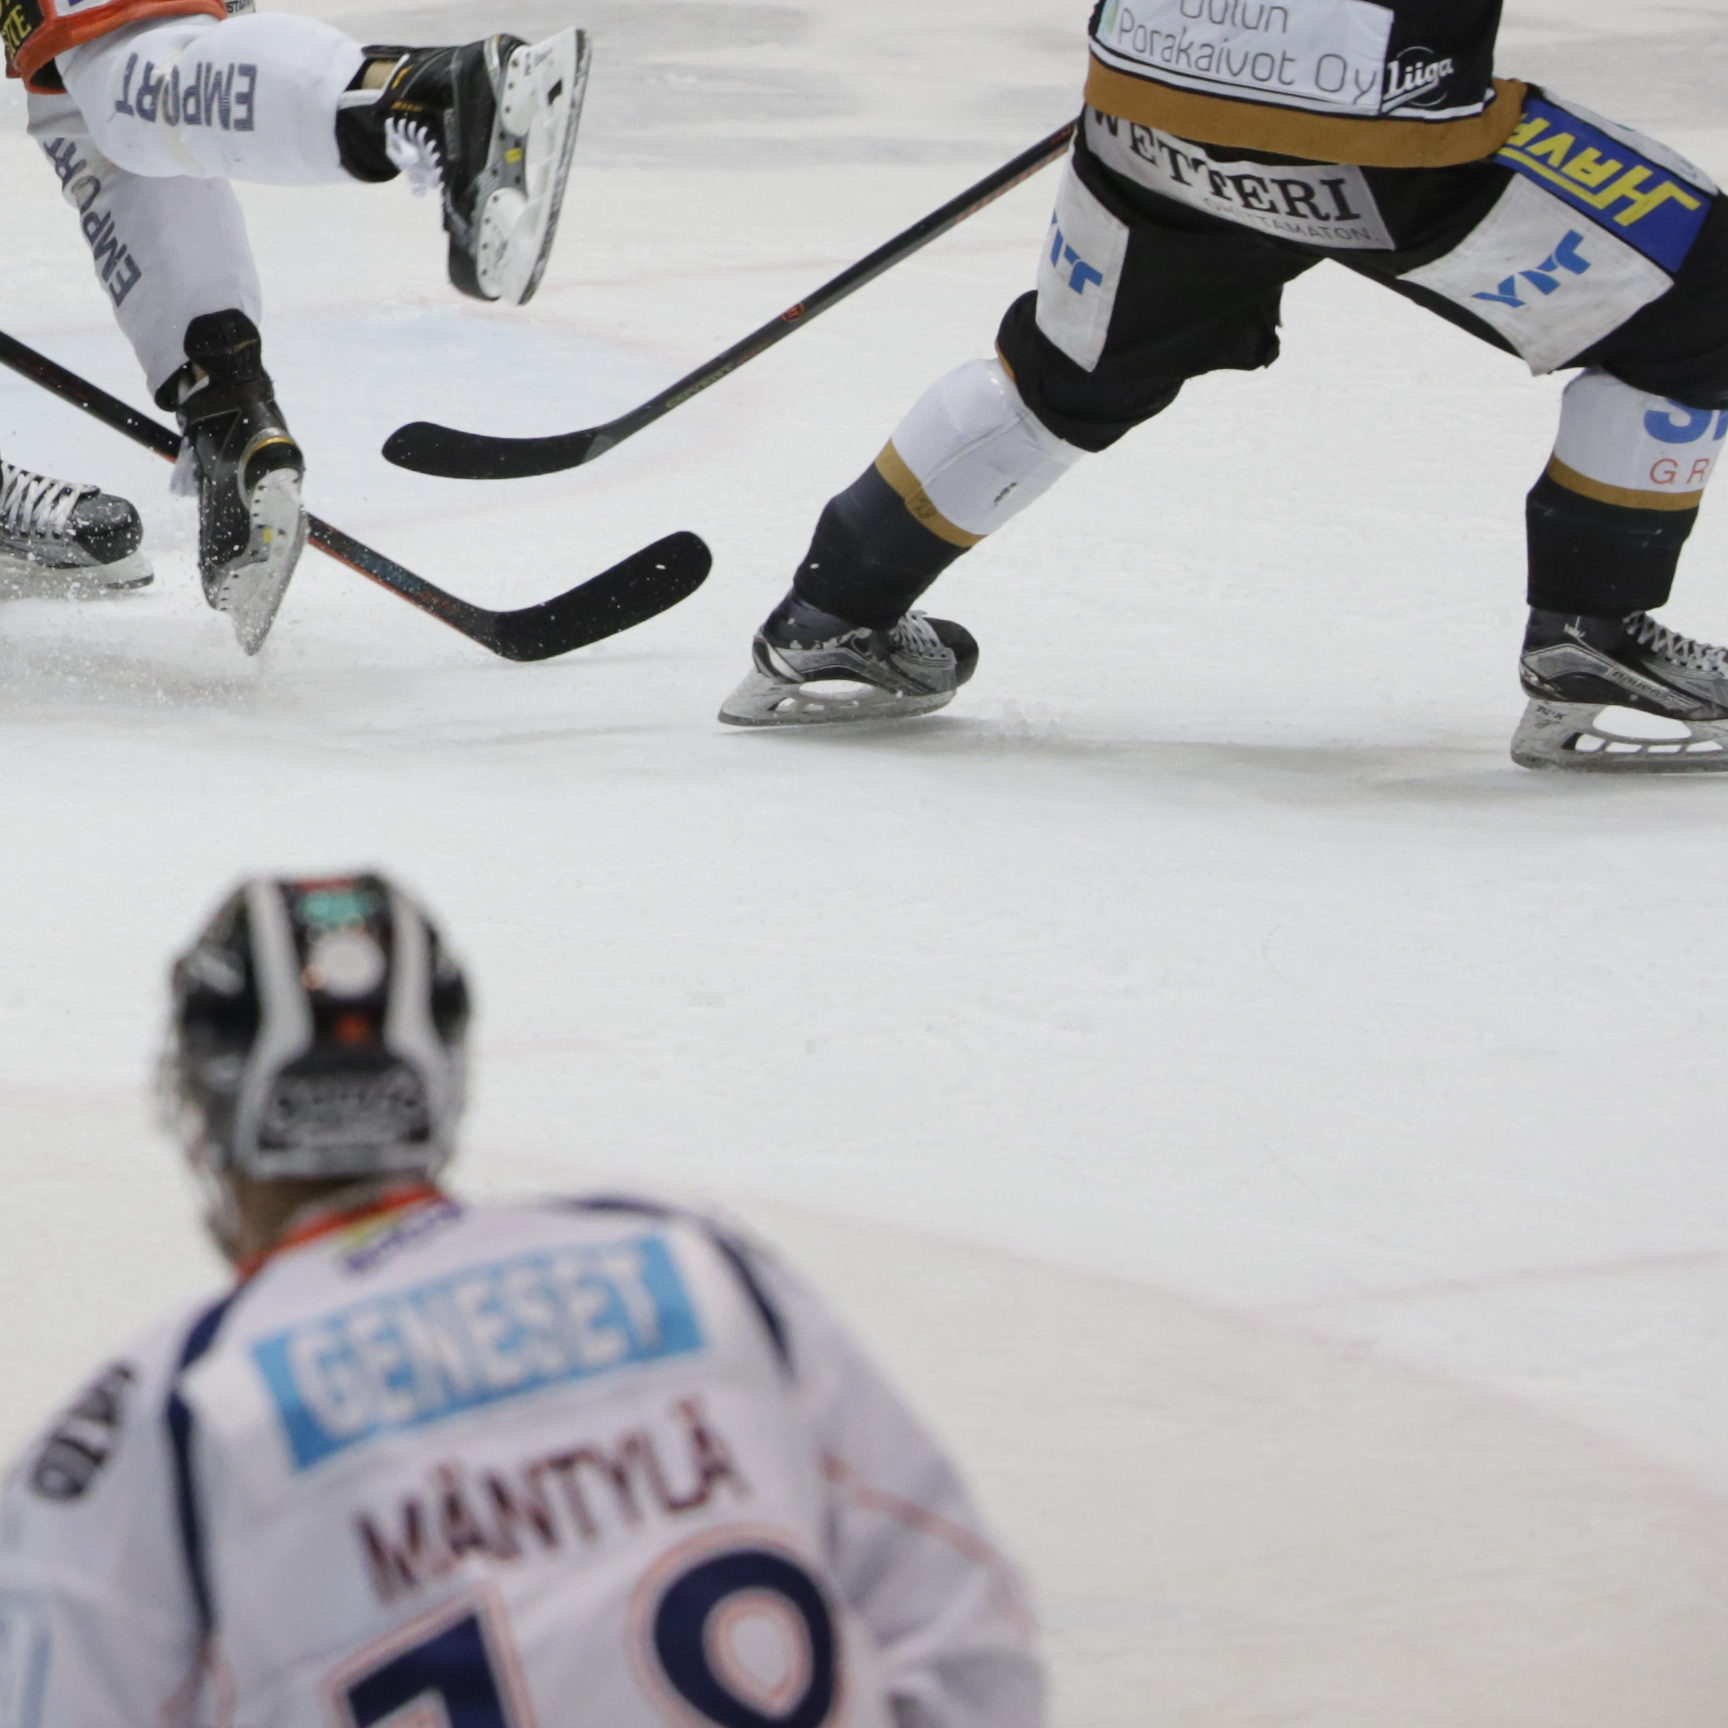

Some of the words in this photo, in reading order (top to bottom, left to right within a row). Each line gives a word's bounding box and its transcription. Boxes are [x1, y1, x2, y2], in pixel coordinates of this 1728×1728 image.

[1119, 14, 1296, 87] Porakaivot
[1473, 228, 1591, 310] YIT
[292, 1247, 672, 1433] GENESET
